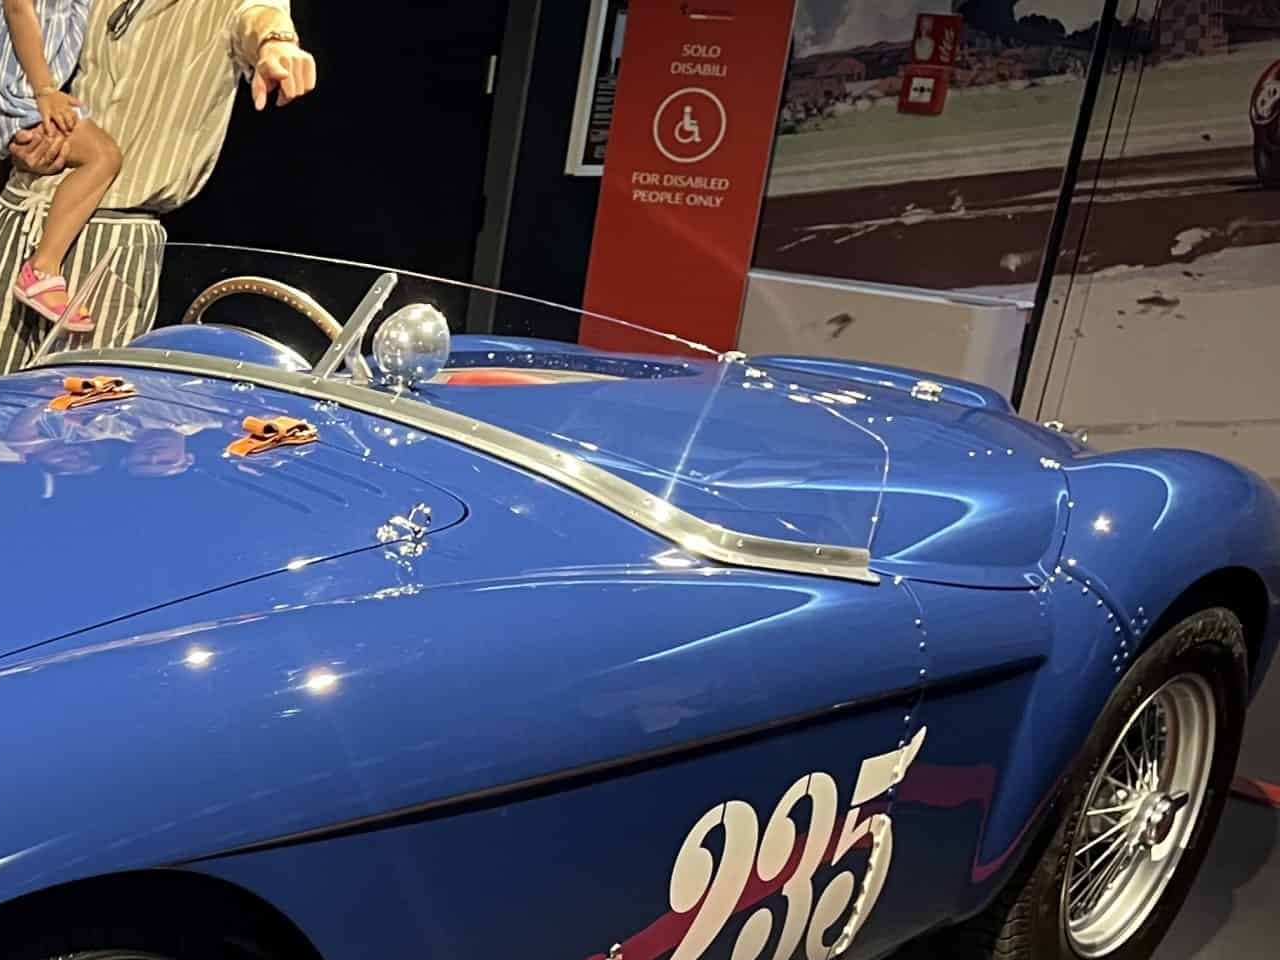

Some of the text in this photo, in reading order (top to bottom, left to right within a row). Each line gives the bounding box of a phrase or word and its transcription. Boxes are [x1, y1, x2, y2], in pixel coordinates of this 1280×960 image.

[682, 43, 722, 58] SOLO
[671, 61, 728, 77] DISABILI
[631, 171, 729, 190] FOR DISABLED
[632, 189, 725, 208] PEOPLE ONLY
